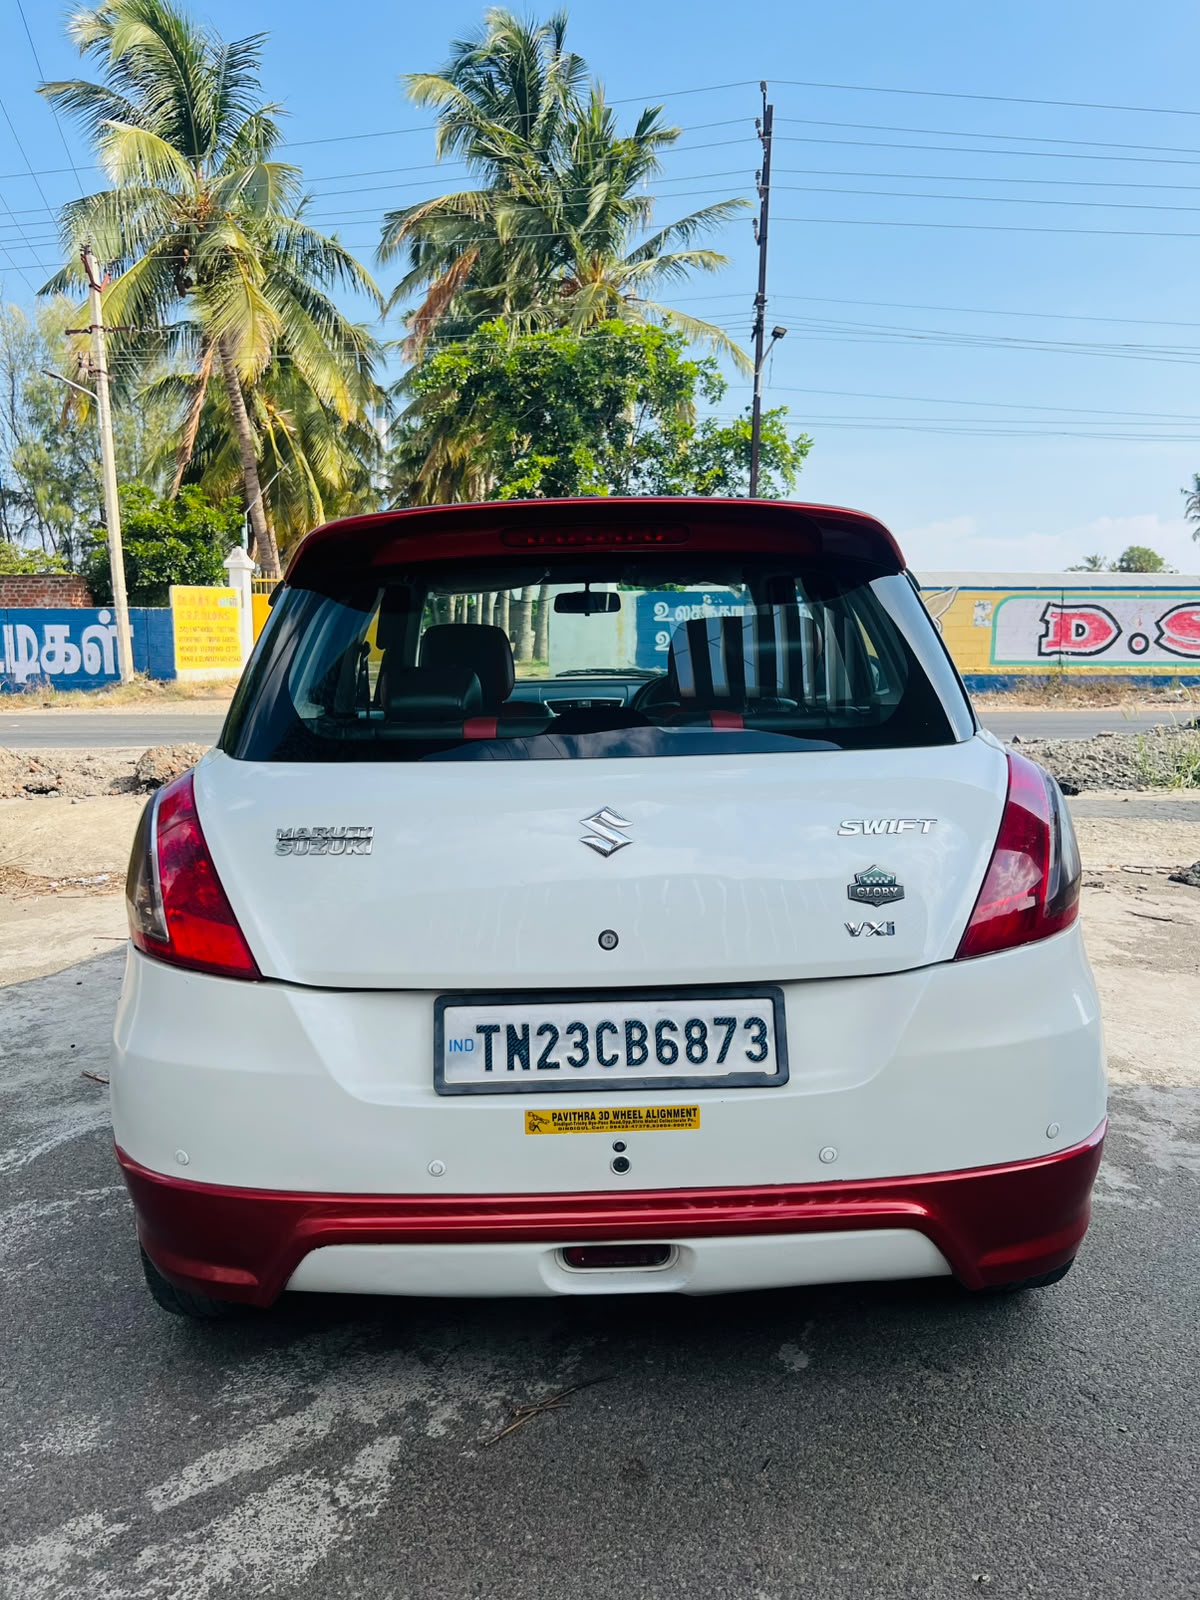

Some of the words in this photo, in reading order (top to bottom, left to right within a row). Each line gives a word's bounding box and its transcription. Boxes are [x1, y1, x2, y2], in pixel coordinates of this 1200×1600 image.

[276, 826, 375, 840] MARUTI
[837, 818, 938, 836] SWIFT
[275, 839, 373, 856] SUZUKI
[856, 886, 898, 897] GLORY
[844, 921, 895, 937] VXi
[449, 1038, 474, 1052] IND
[476, 1016, 768, 1072] TN23CB6873
[551, 1111, 596, 1122] PAVITHRA
[598, 1110, 610, 1120] 3D
[612, 1109, 643, 1120] WHEEL
[645, 1107, 698, 1119] ALIGNMENT
